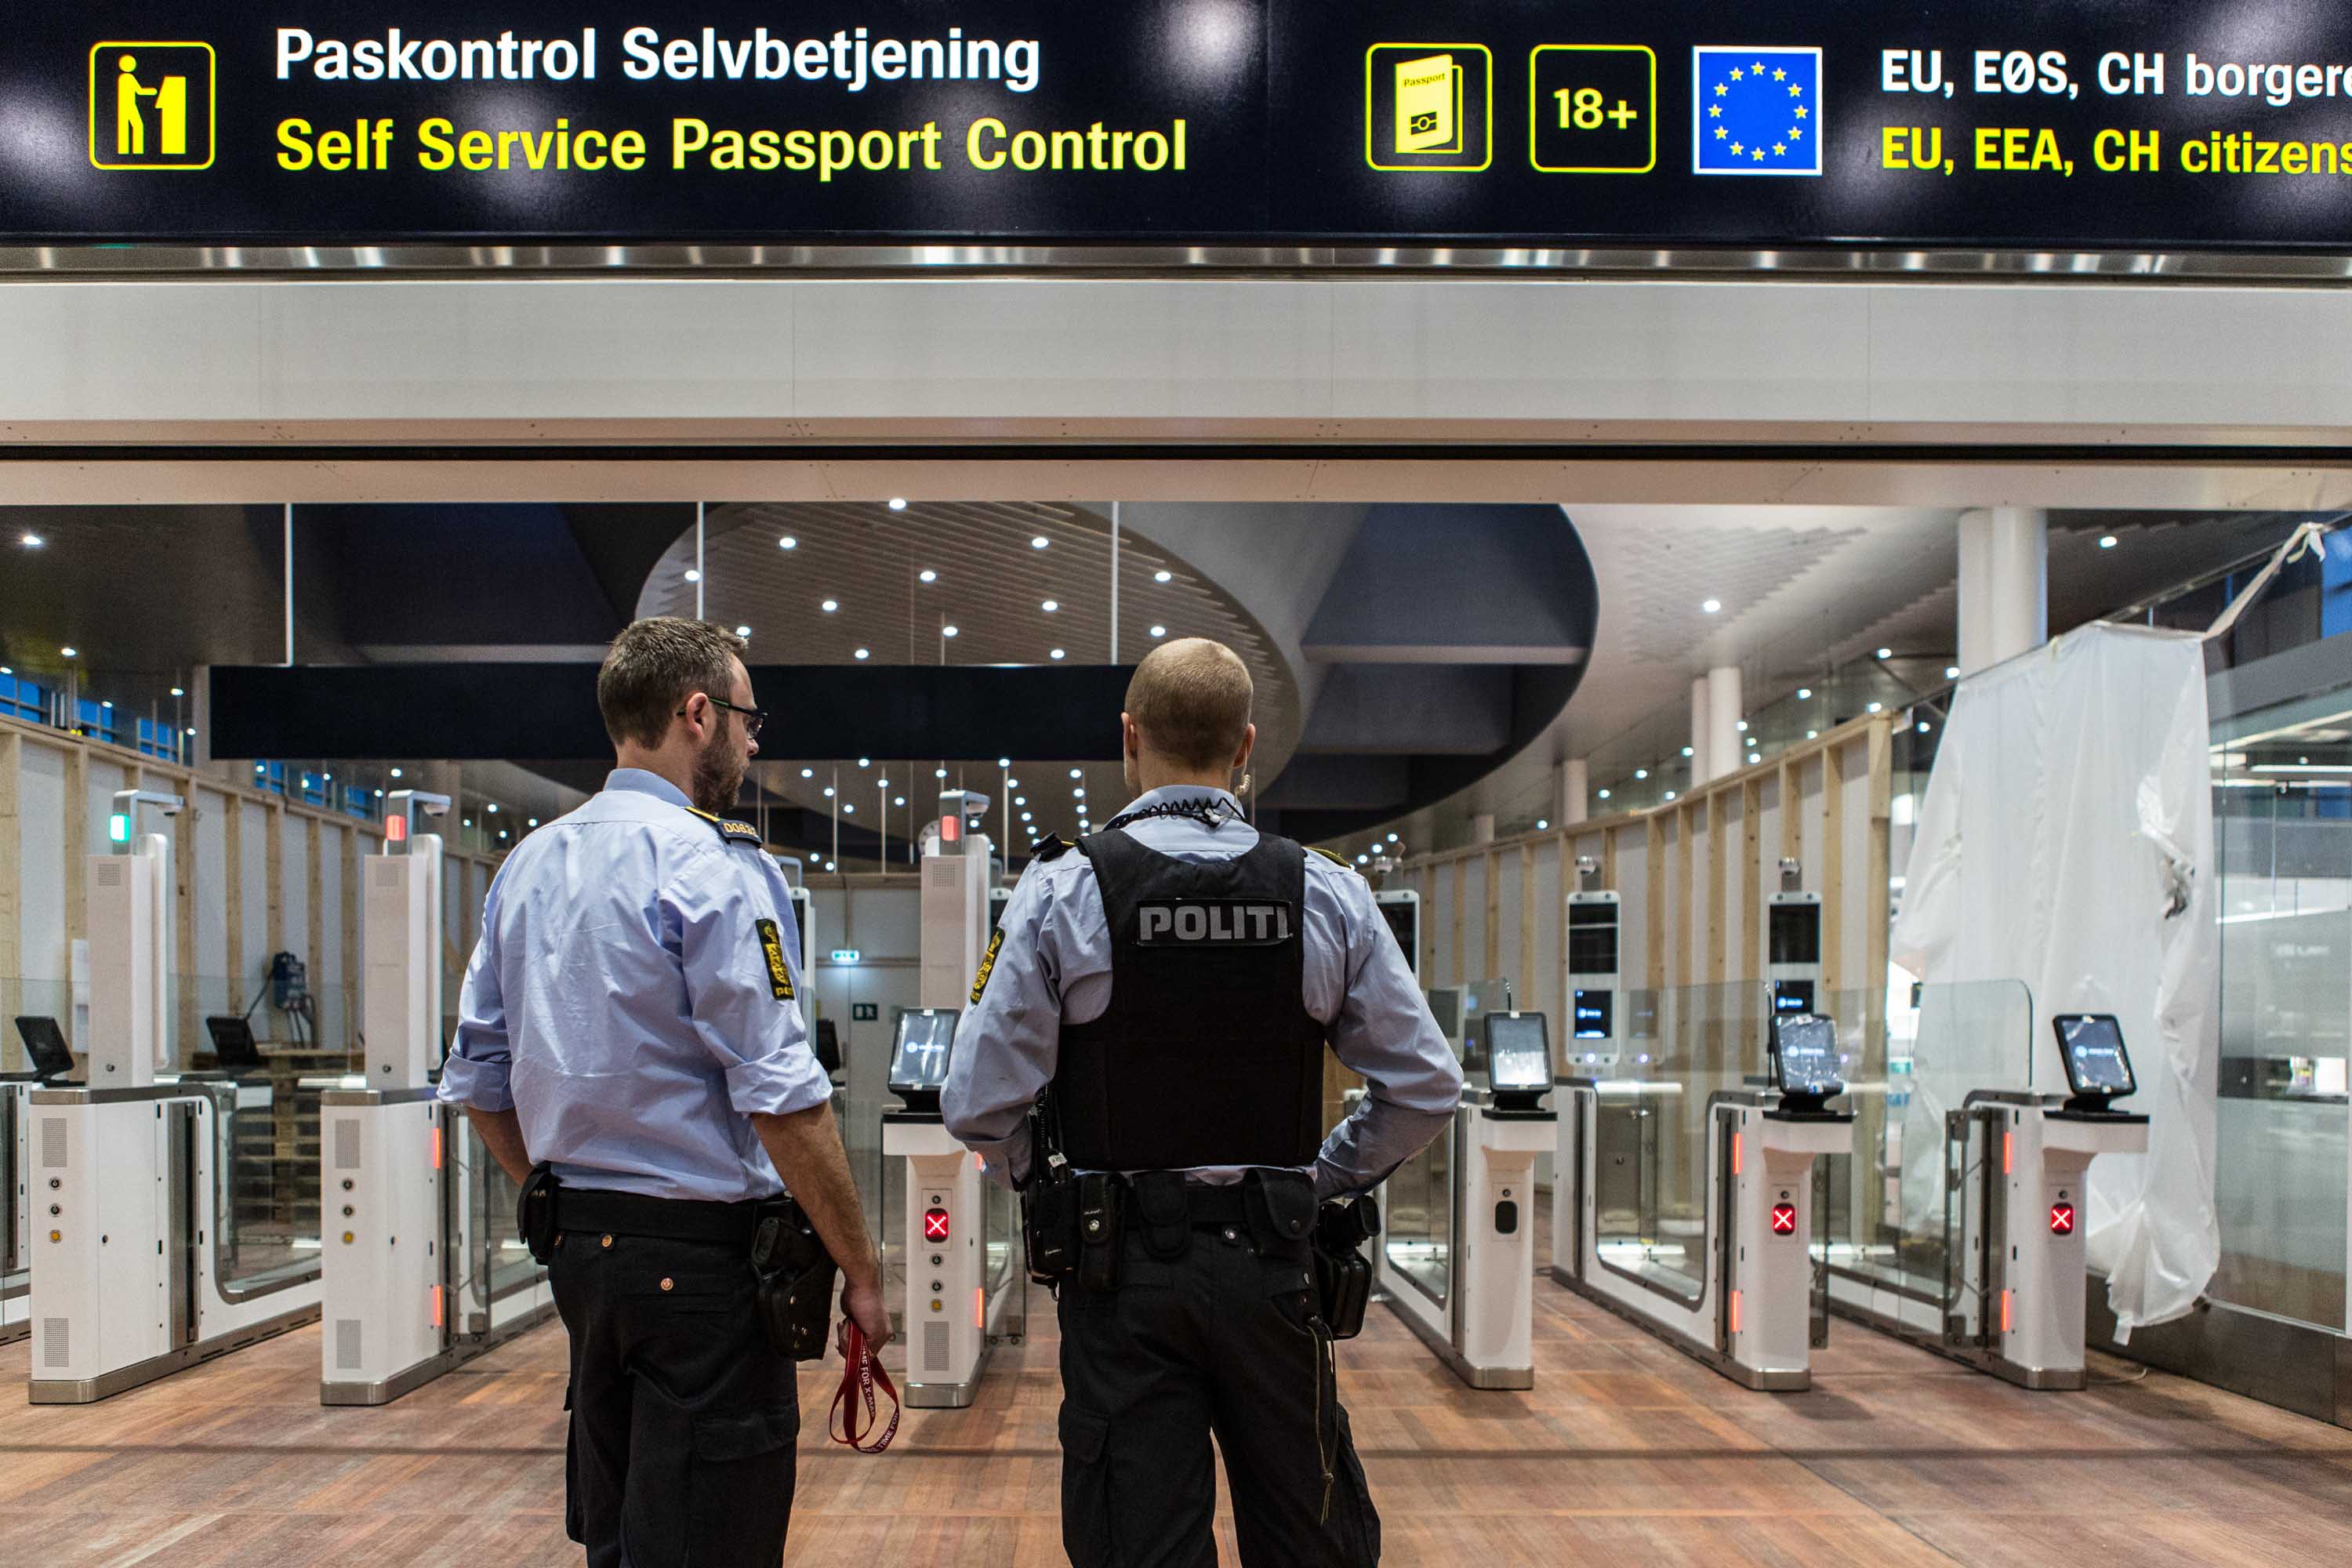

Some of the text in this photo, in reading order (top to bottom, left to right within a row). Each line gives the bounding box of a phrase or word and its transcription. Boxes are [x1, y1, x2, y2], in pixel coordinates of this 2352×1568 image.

[277, 27, 1039, 92] Paskontrol Selvbetjening
[1403, 72, 1446, 87] Passport
[1882, 49, 1954, 98] EU,
[1975, 51, 2078, 100] EØS,
[2098, 52, 2165, 94] CH
[1553, 88, 1638, 129] 18+
[277, 118, 1186, 182] Self Service Passport Control
[1882, 126, 1955, 175] EU,
[1975, 128, 2074, 177] EEA,
[2093, 129, 2159, 172] CH
[1139, 906, 1288, 940] POLITI
[860, 1367, 869, 1385] FOR
[877, 1429, 893, 1449] TIME
